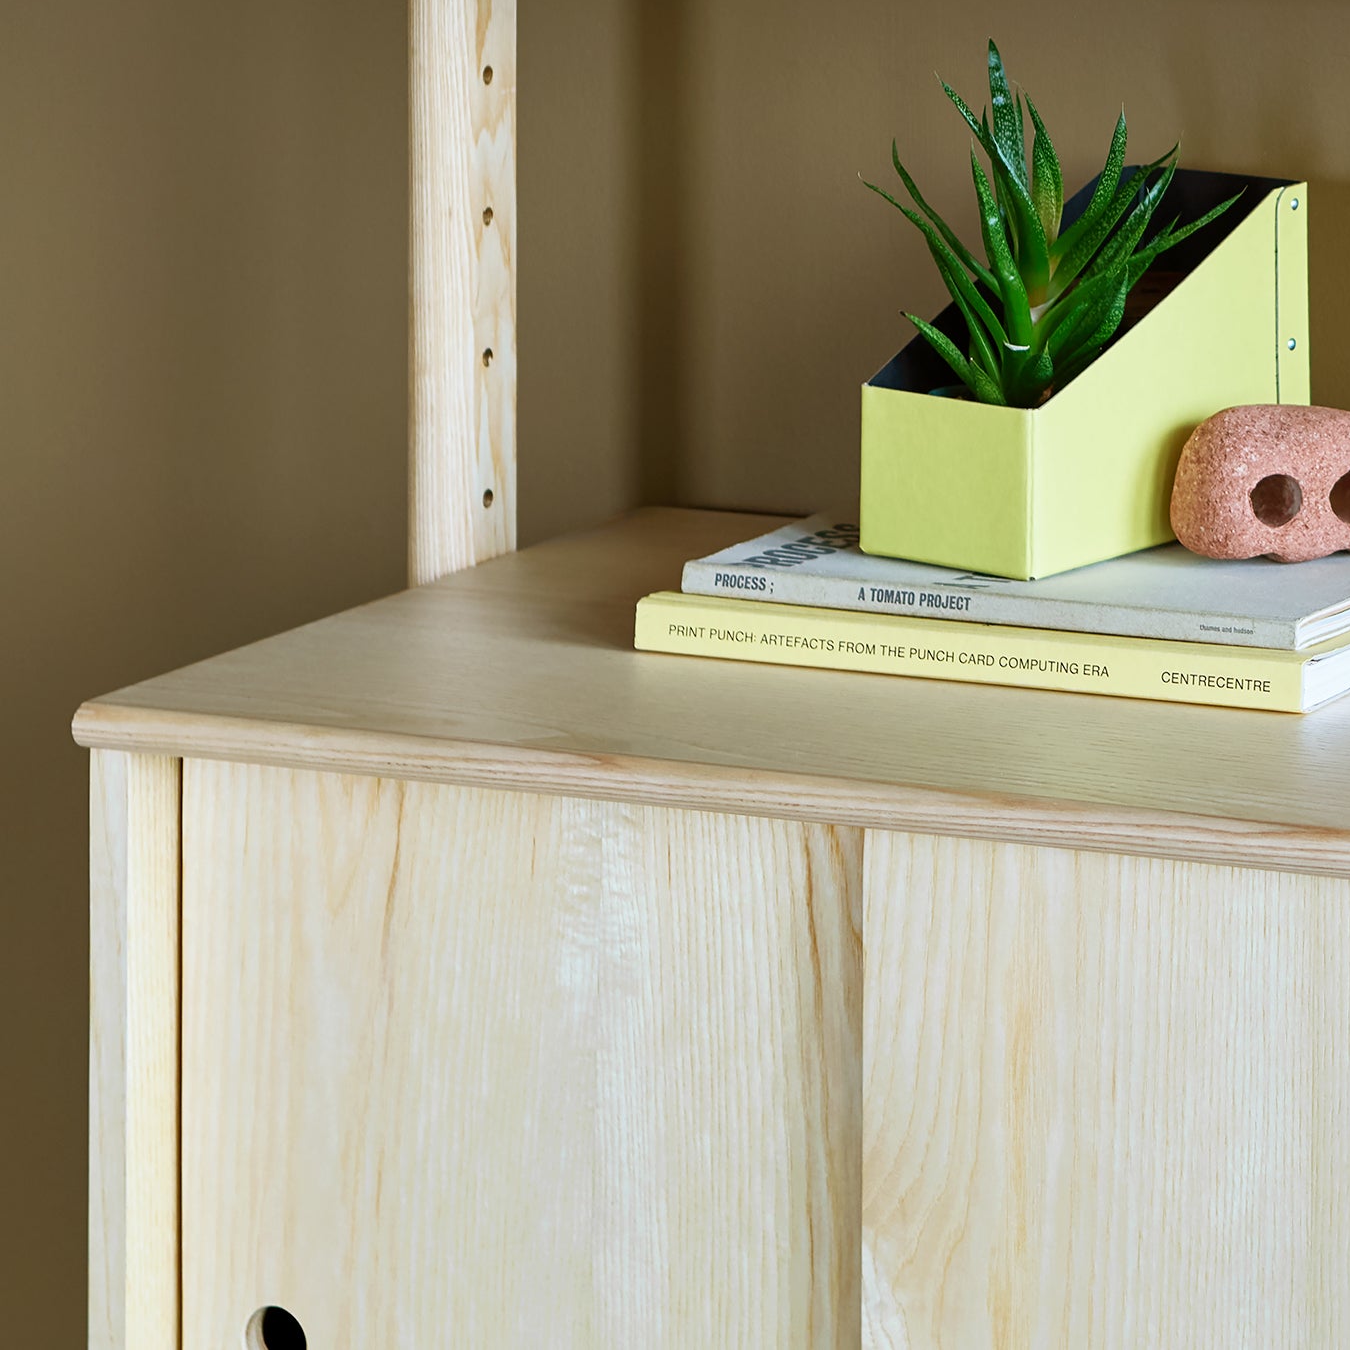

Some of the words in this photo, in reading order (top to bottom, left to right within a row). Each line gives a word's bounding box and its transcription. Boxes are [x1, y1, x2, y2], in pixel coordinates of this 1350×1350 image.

[714, 573, 767, 591] PROCESS
[858, 587, 866, 601] A
[870, 588, 915, 606] TOMATO
[919, 593, 971, 611] PROJECT
[1199, 624, 1220, 632] thames
[1233, 626, 1254, 635] hudson
[668, 624, 706, 639] PRINT
[709, 628, 757, 644] PUNCH:
[760, 633, 835, 652] ARTEFACTS
[838, 640, 876, 655] FROM
[880, 644, 905, 659] THE
[909, 647, 955, 663] PUNCH
[958, 652, 995, 667] CARD
[998, 656, 1079, 675] COMPUTING
[1083, 664, 1110, 678] ERA
[1161, 671, 1271, 693] CENTRECENTRE
